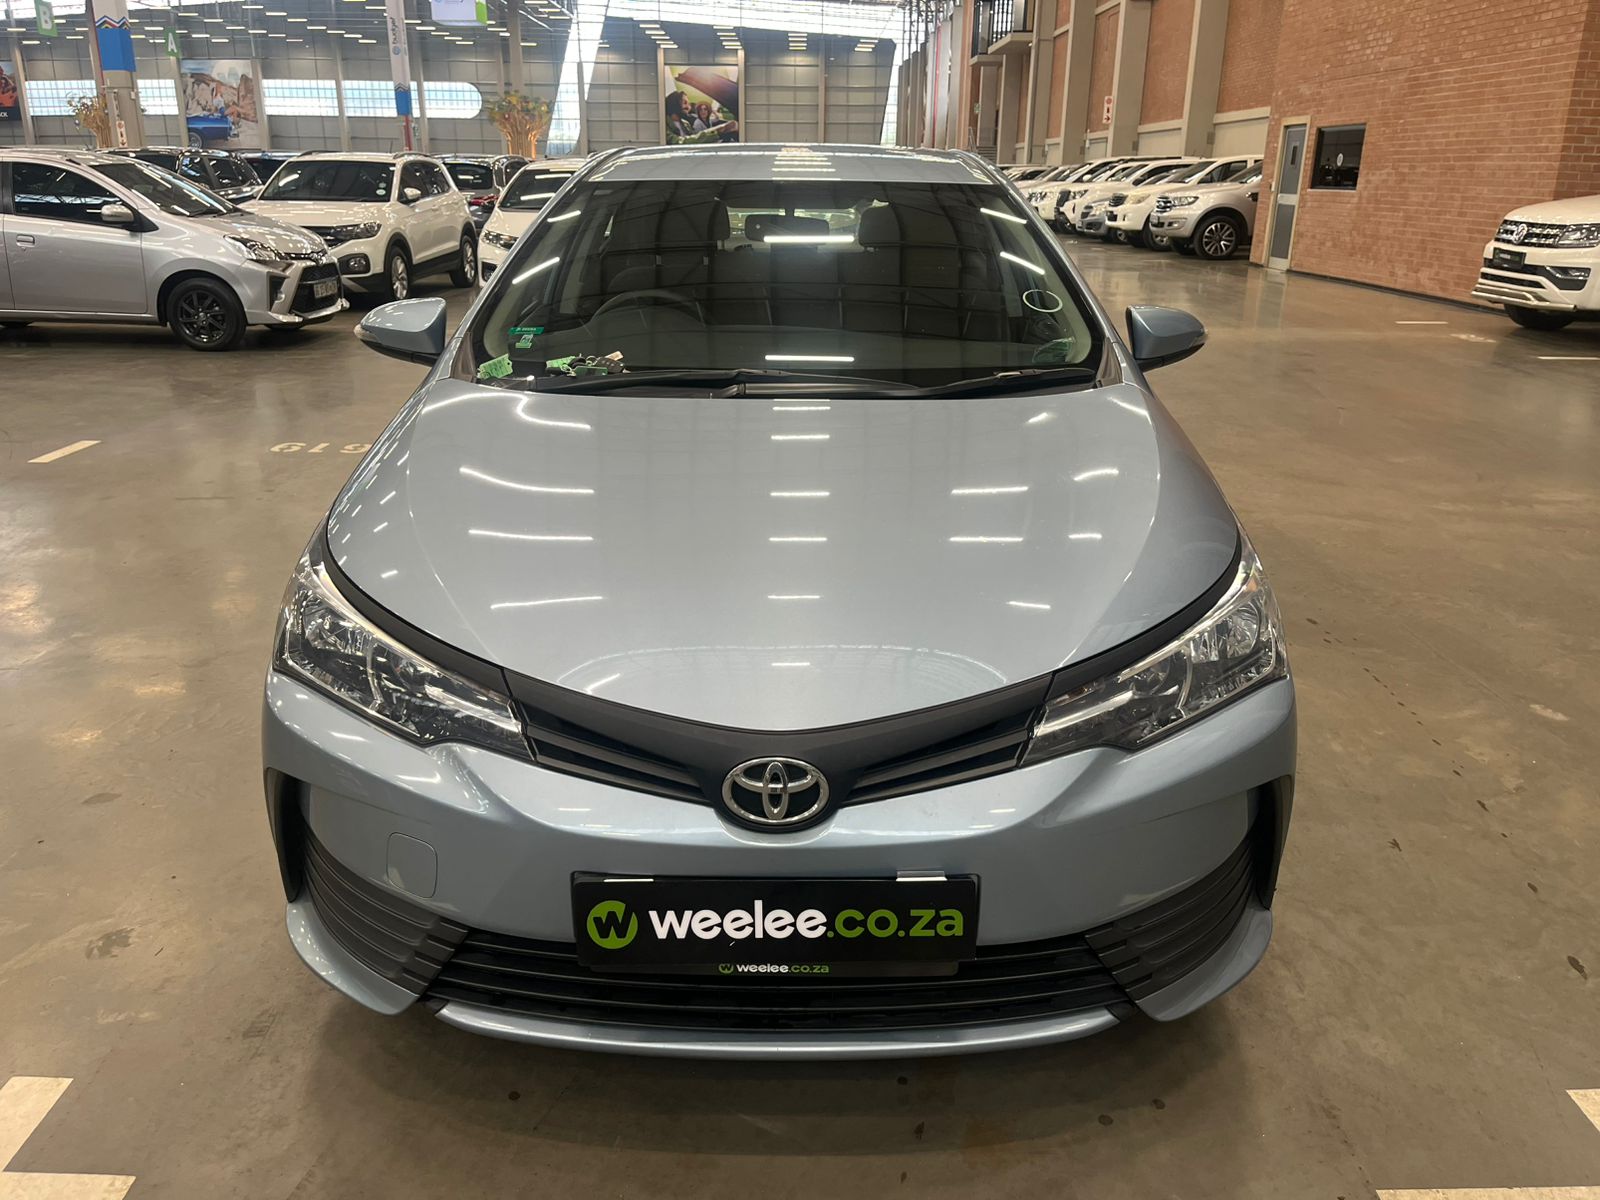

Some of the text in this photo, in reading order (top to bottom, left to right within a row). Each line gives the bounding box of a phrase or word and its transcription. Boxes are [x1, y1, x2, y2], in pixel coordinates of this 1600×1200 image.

[39, 1, 53, 30] B
[167, 32, 178, 53] A
[648, 900, 964, 940] weelee.co.za
[736, 963, 830, 973] weelee.co.za
